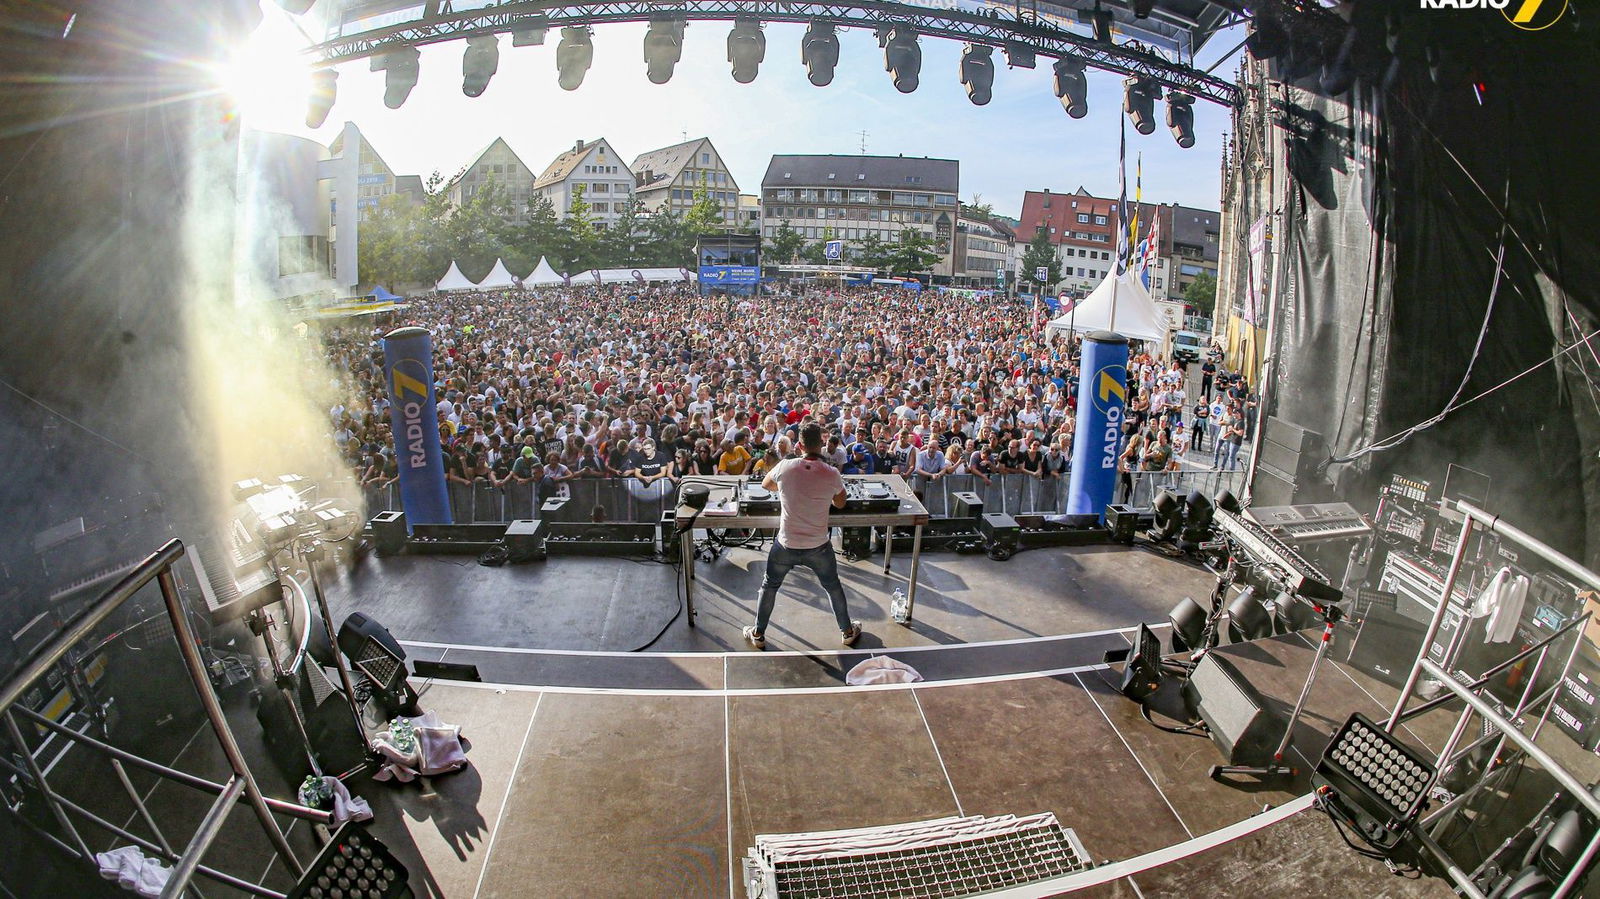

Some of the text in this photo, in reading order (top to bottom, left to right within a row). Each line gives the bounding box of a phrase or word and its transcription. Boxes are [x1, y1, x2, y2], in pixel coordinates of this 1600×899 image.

[717, 270, 727, 281] 7
[392, 367, 428, 468] RADIO 7
[1099, 370, 1126, 469] RADIO 7
